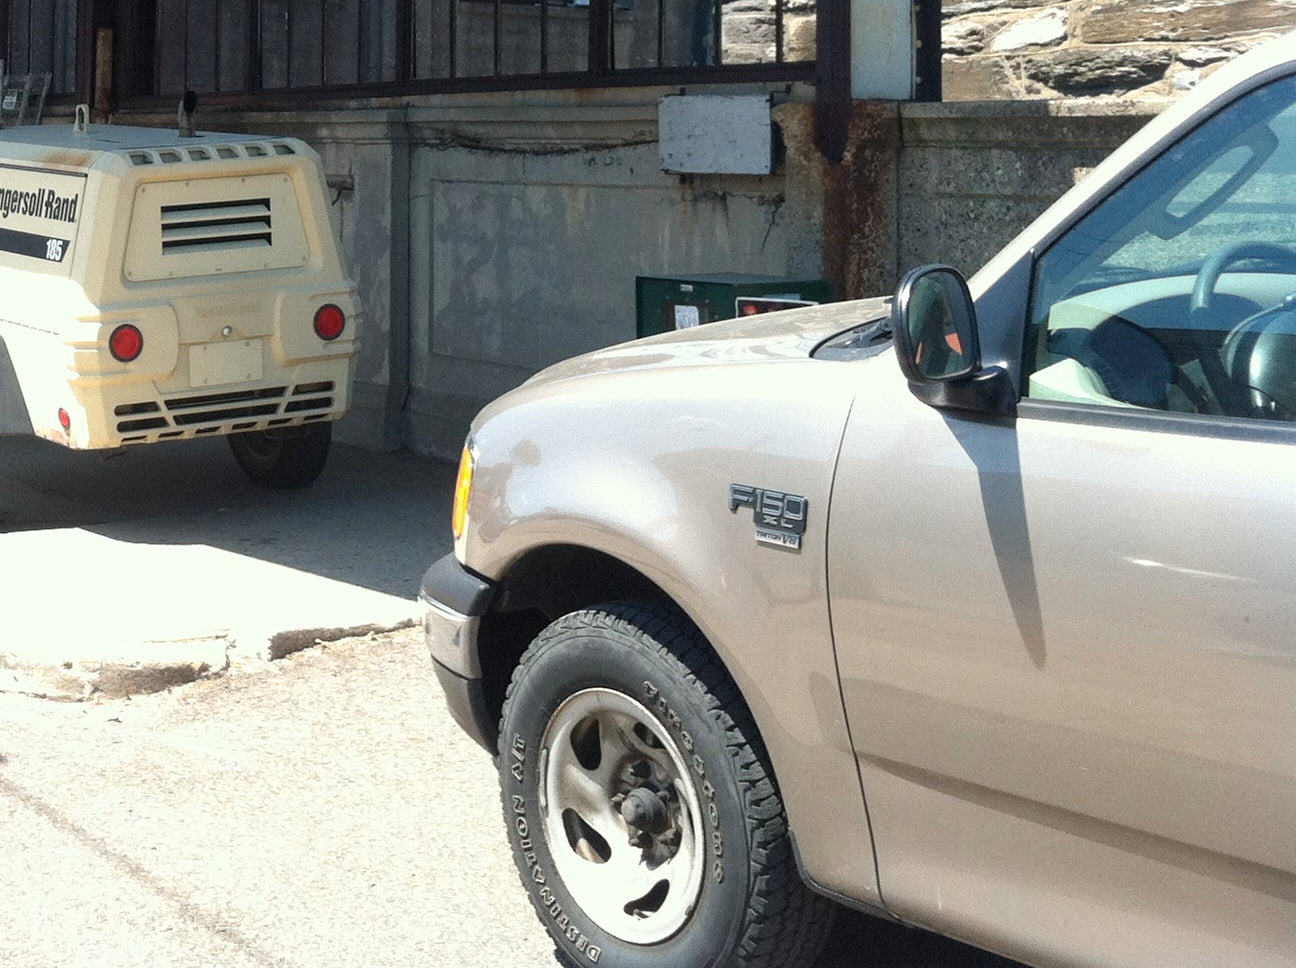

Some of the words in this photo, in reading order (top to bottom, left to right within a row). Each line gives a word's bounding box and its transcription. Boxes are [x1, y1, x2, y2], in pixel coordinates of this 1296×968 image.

[46, 239, 64, 261] 185
[764, 514, 793, 528] XL
[782, 533, 797, 545] V8
[511, 733, 526, 782] A/T
[512, 794, 602, 964] DESTINATION
